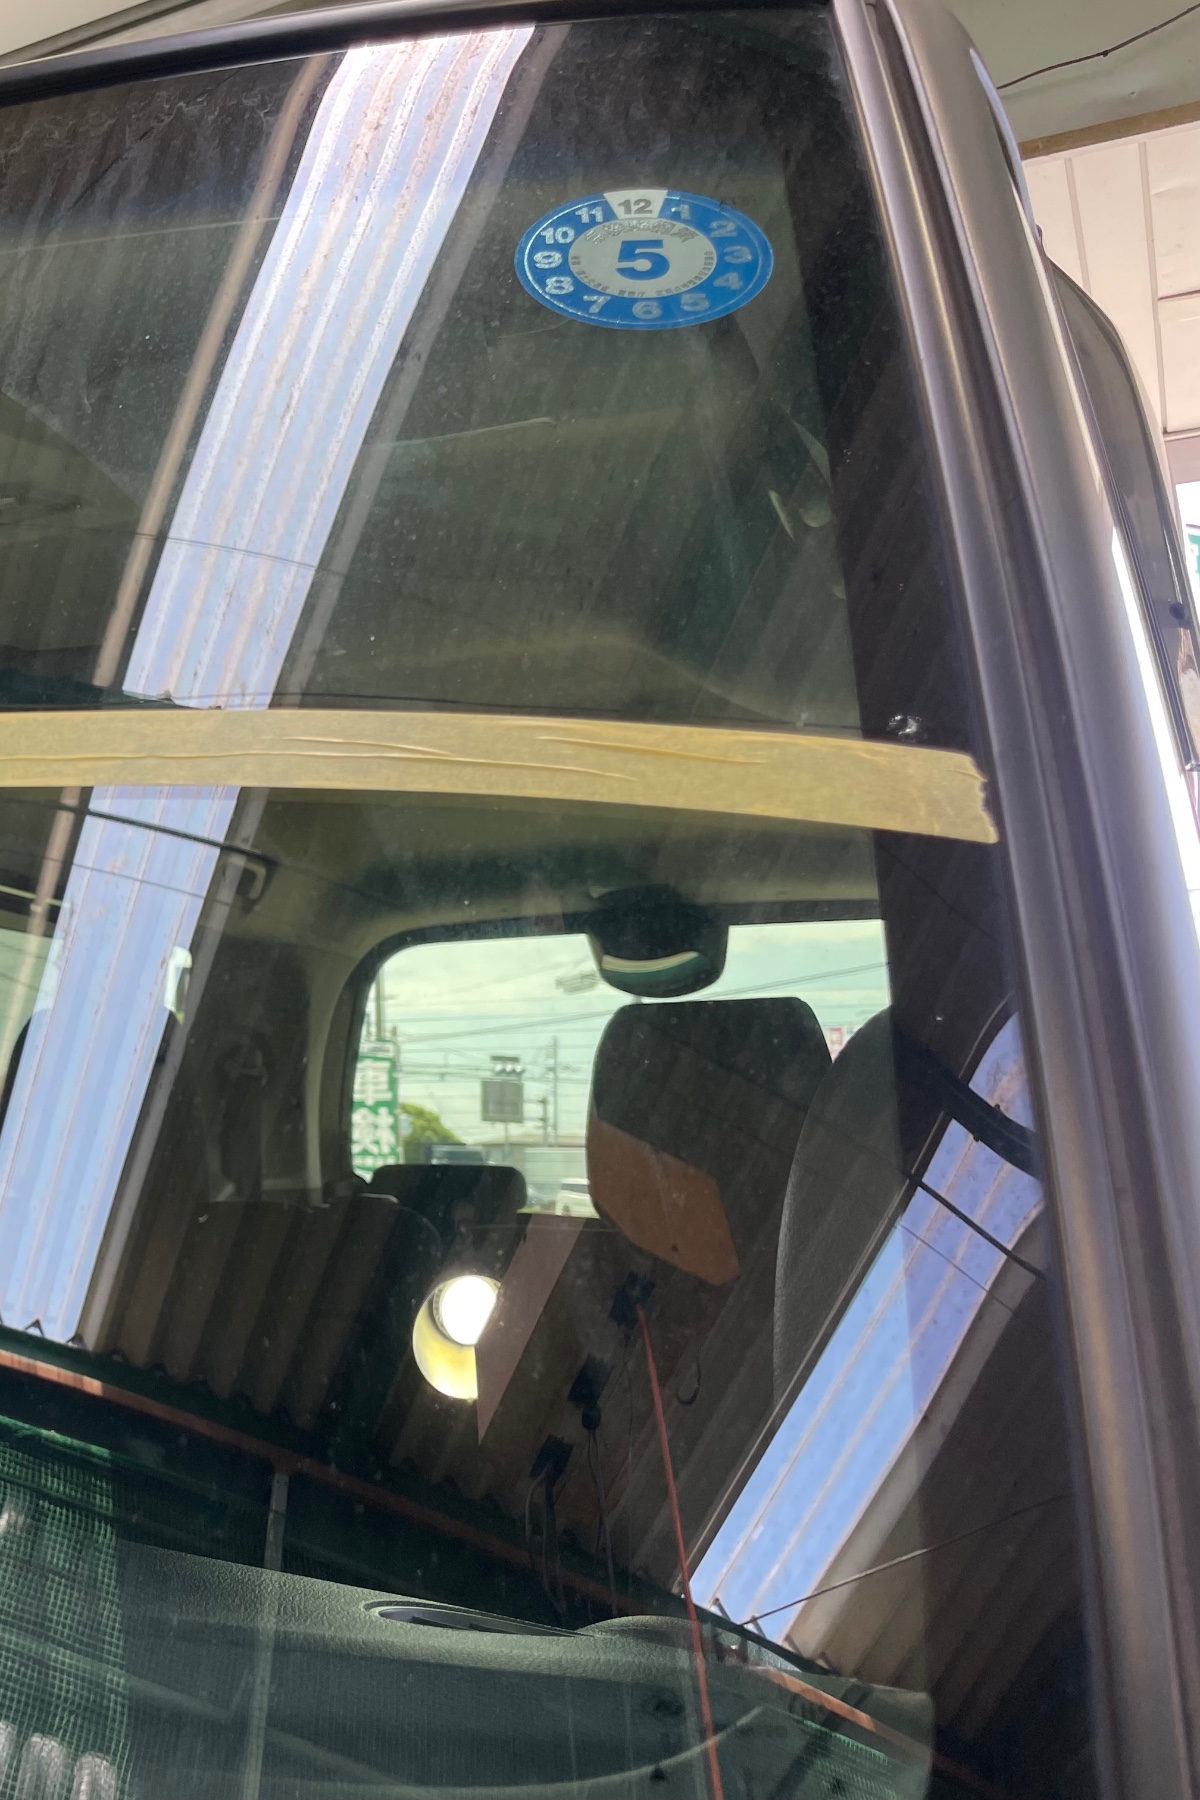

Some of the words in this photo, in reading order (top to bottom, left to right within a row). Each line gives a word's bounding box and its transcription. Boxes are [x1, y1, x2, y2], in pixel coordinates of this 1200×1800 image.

[575, 206, 604, 223] 11
[618, 198, 653, 215] 12
[671, 204, 692, 220] 1
[540, 226, 576, 245] 10
[709, 220, 738, 238] 2
[533, 251, 563, 269] 9
[616, 239, 671, 281] 5
[724, 246, 753, 264] 3
[545, 276, 575, 295] 8
[713, 272, 744, 290] 4
[582, 295, 611, 314] 7
[632, 301, 662, 319] 6
[680, 293, 710, 312] 5
